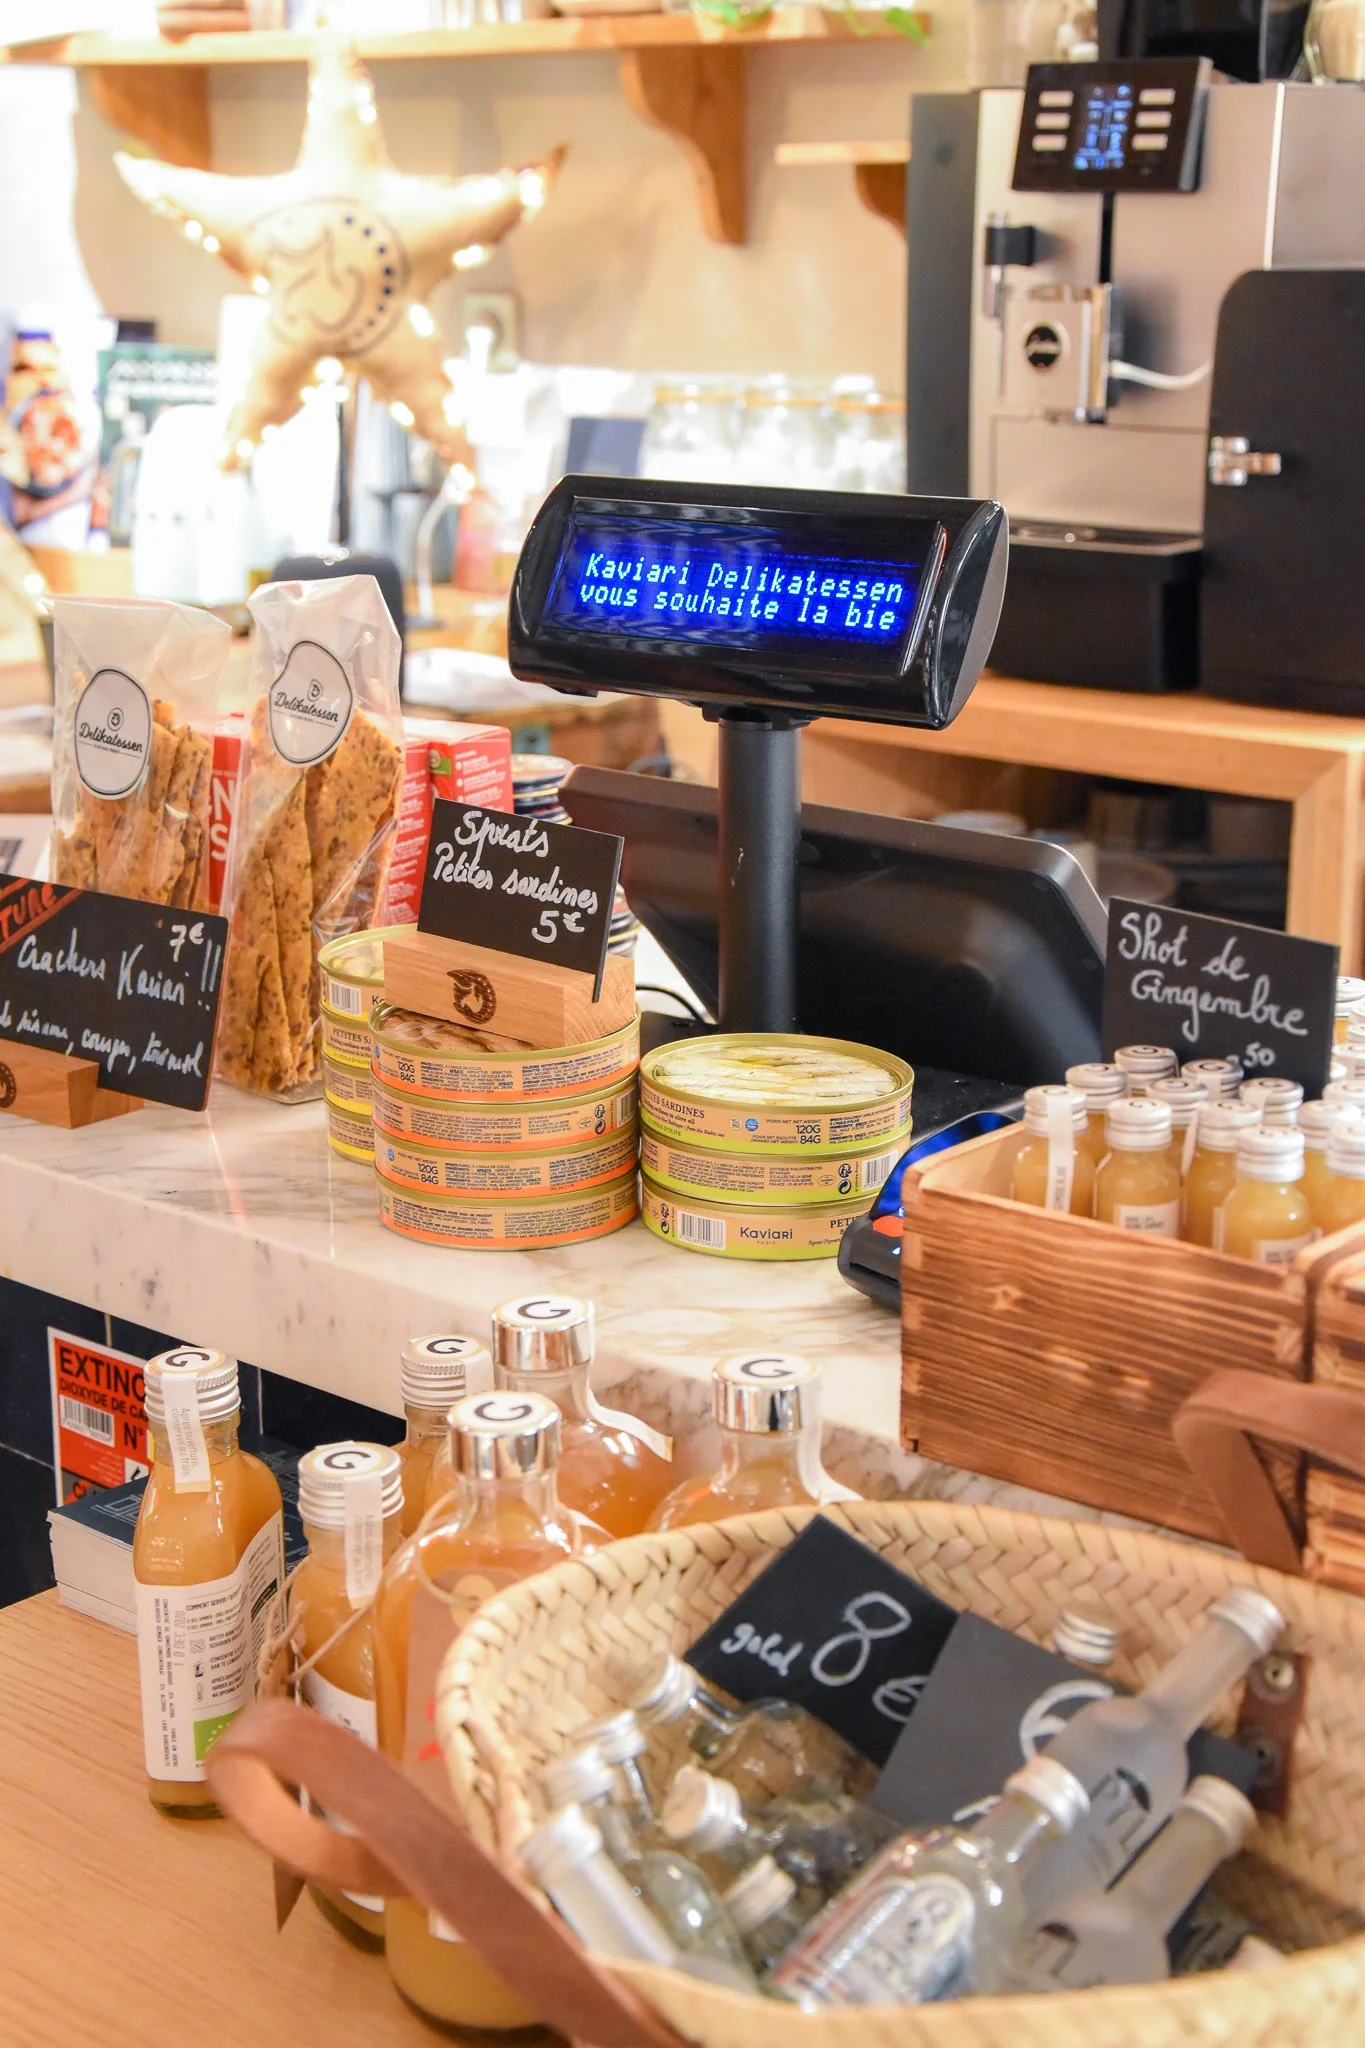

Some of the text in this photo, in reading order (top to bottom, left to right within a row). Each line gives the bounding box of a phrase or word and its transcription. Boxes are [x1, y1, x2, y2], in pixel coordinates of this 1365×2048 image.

[585, 553, 902, 603] Kaviari Delikatessen
[580, 584, 897, 631] vous souhaite la bie
[274, 691, 338, 722] Delikatessen
[79, 722, 143, 753] Delikatessen
[454, 810, 549, 866] Sprats
[433, 842, 493, 890] Petites
[501, 866, 599, 914] sardines
[531, 910, 585, 943] 5€
[170, 922, 205, 962] 7€
[1119, 912, 1250, 981] Shot de
[1131, 970, 1308, 1043] Gingembre
[397, 1060, 415, 1074] 120G
[400, 1073, 415, 1083] 84G
[661, 1099, 705, 1119] SARDINES
[796, 1124, 821, 1134] 120G
[800, 1135, 821, 1144] 84G
[418, 1163, 438, 1175] 120G
[421, 1175, 439, 1185] 84G
[830, 1215, 860, 1229] PETI
[517, 1300, 571, 1320] G
[426, 1338, 467, 1355] G
[740, 1359, 793, 1378] G
[60, 1377, 109, 1408] DIOXYDE
[111, 1397, 126, 1415] DE
[474, 1401, 532, 1422] G
[324, 1451, 372, 1470] G
